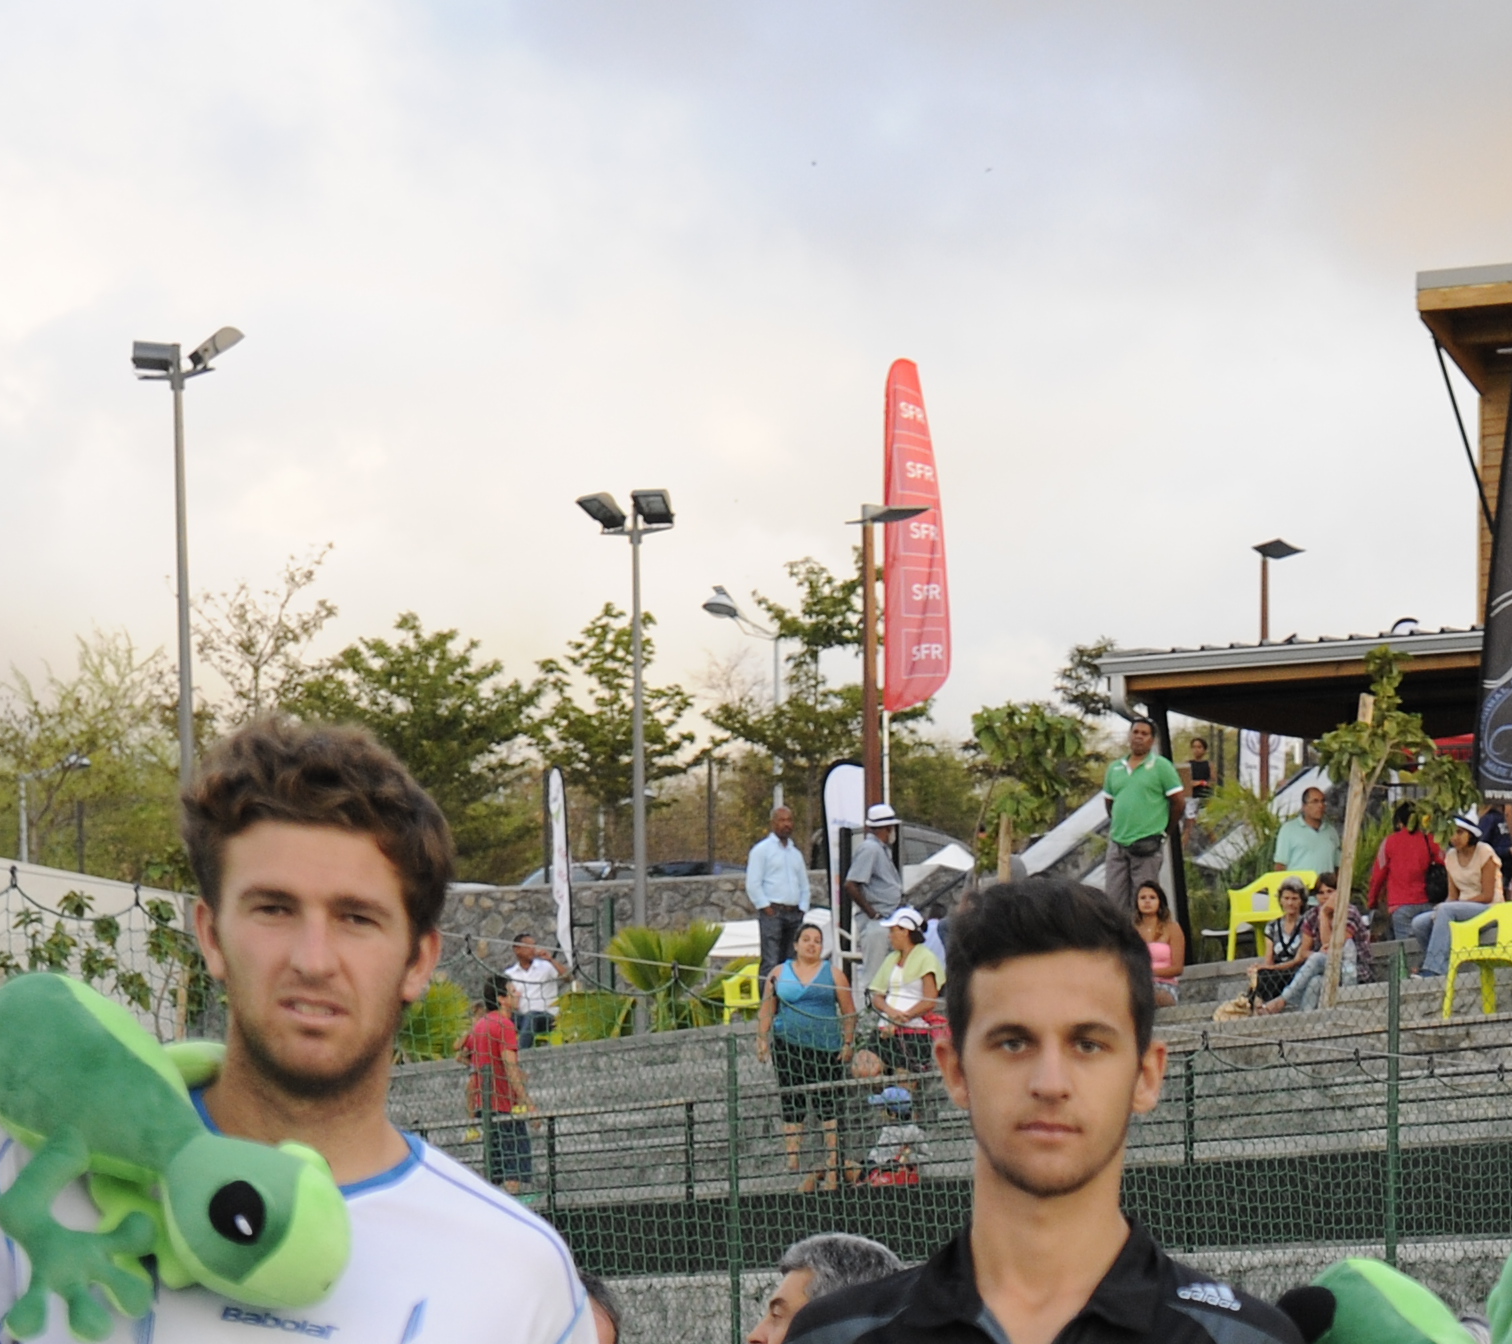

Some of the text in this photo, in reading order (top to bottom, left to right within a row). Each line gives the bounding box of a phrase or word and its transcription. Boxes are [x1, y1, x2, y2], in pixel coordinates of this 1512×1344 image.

[899, 402, 926, 423] SFR
[906, 461, 934, 482] SFR
[910, 522, 939, 540] SFR
[912, 582, 942, 600] SFR
[911, 643, 944, 661] SFR
